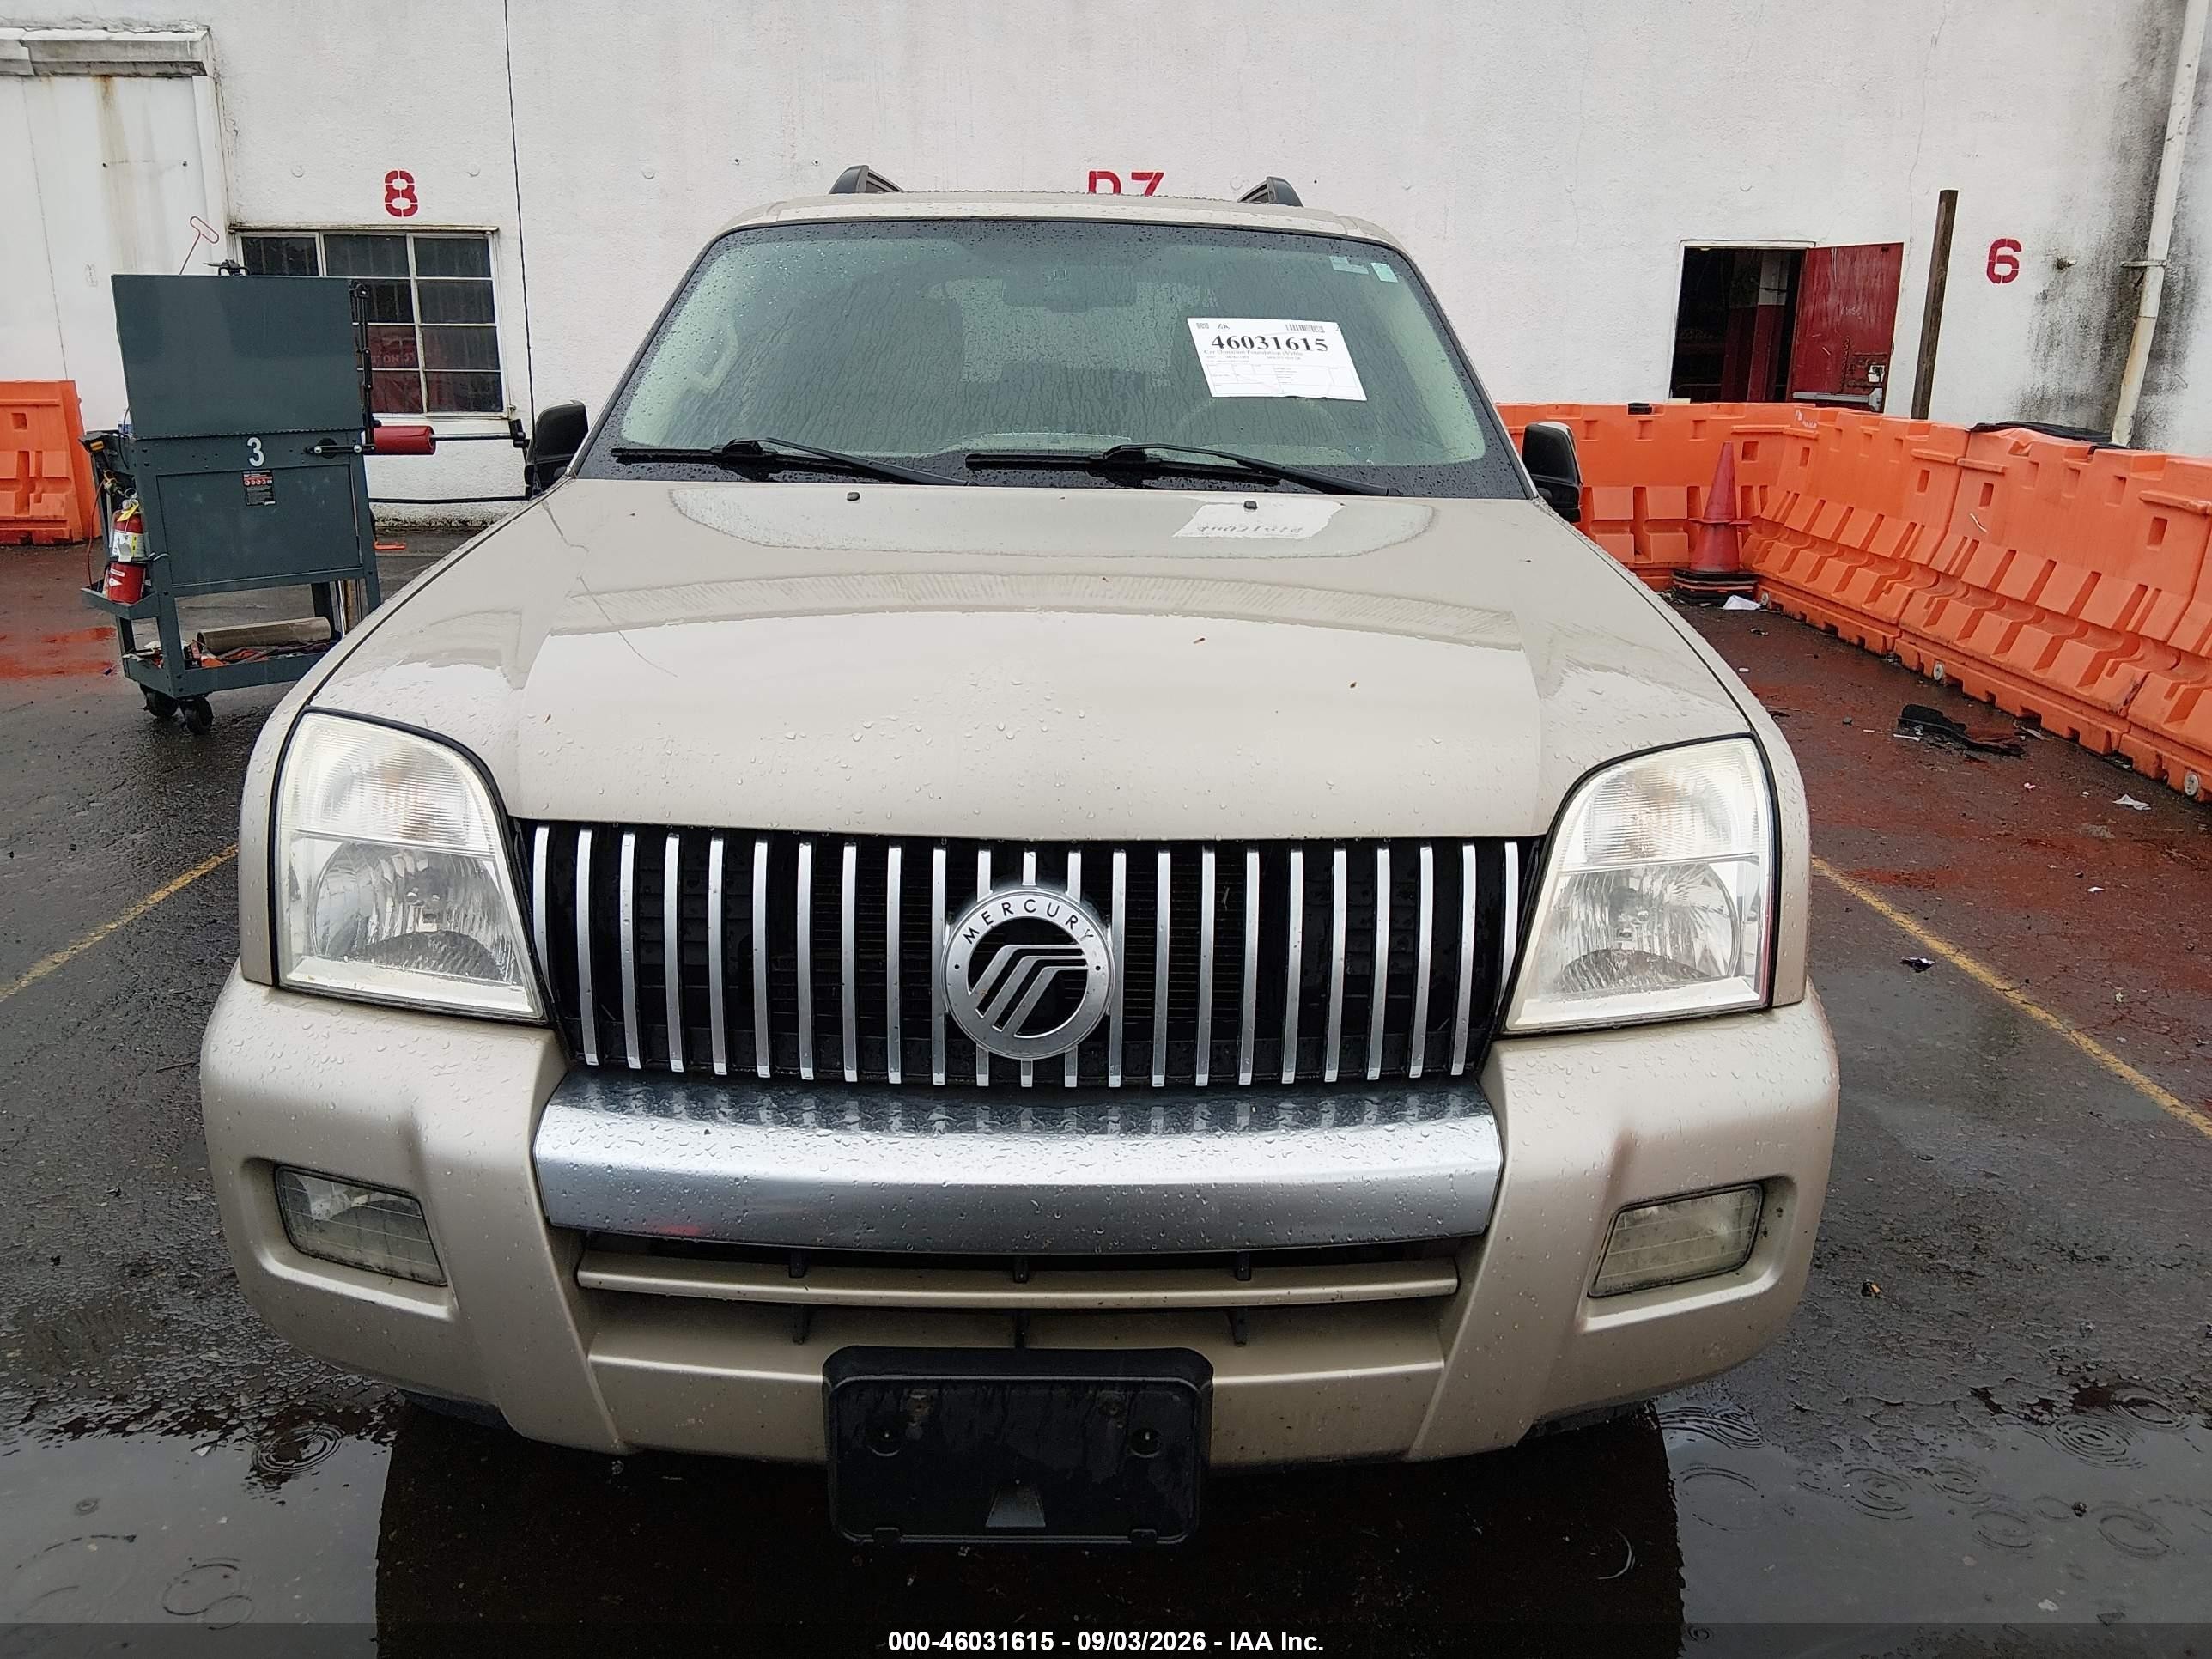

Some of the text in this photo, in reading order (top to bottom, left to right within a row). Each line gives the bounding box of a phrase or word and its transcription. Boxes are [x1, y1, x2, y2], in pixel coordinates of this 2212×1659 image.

[385, 170, 418, 217] 8
[1987, 238, 2021, 284] 6
[1212, 335, 1328, 351] 46031615
[247, 437, 264, 467] 3
[963, 899, 1094, 945] MERCURY
